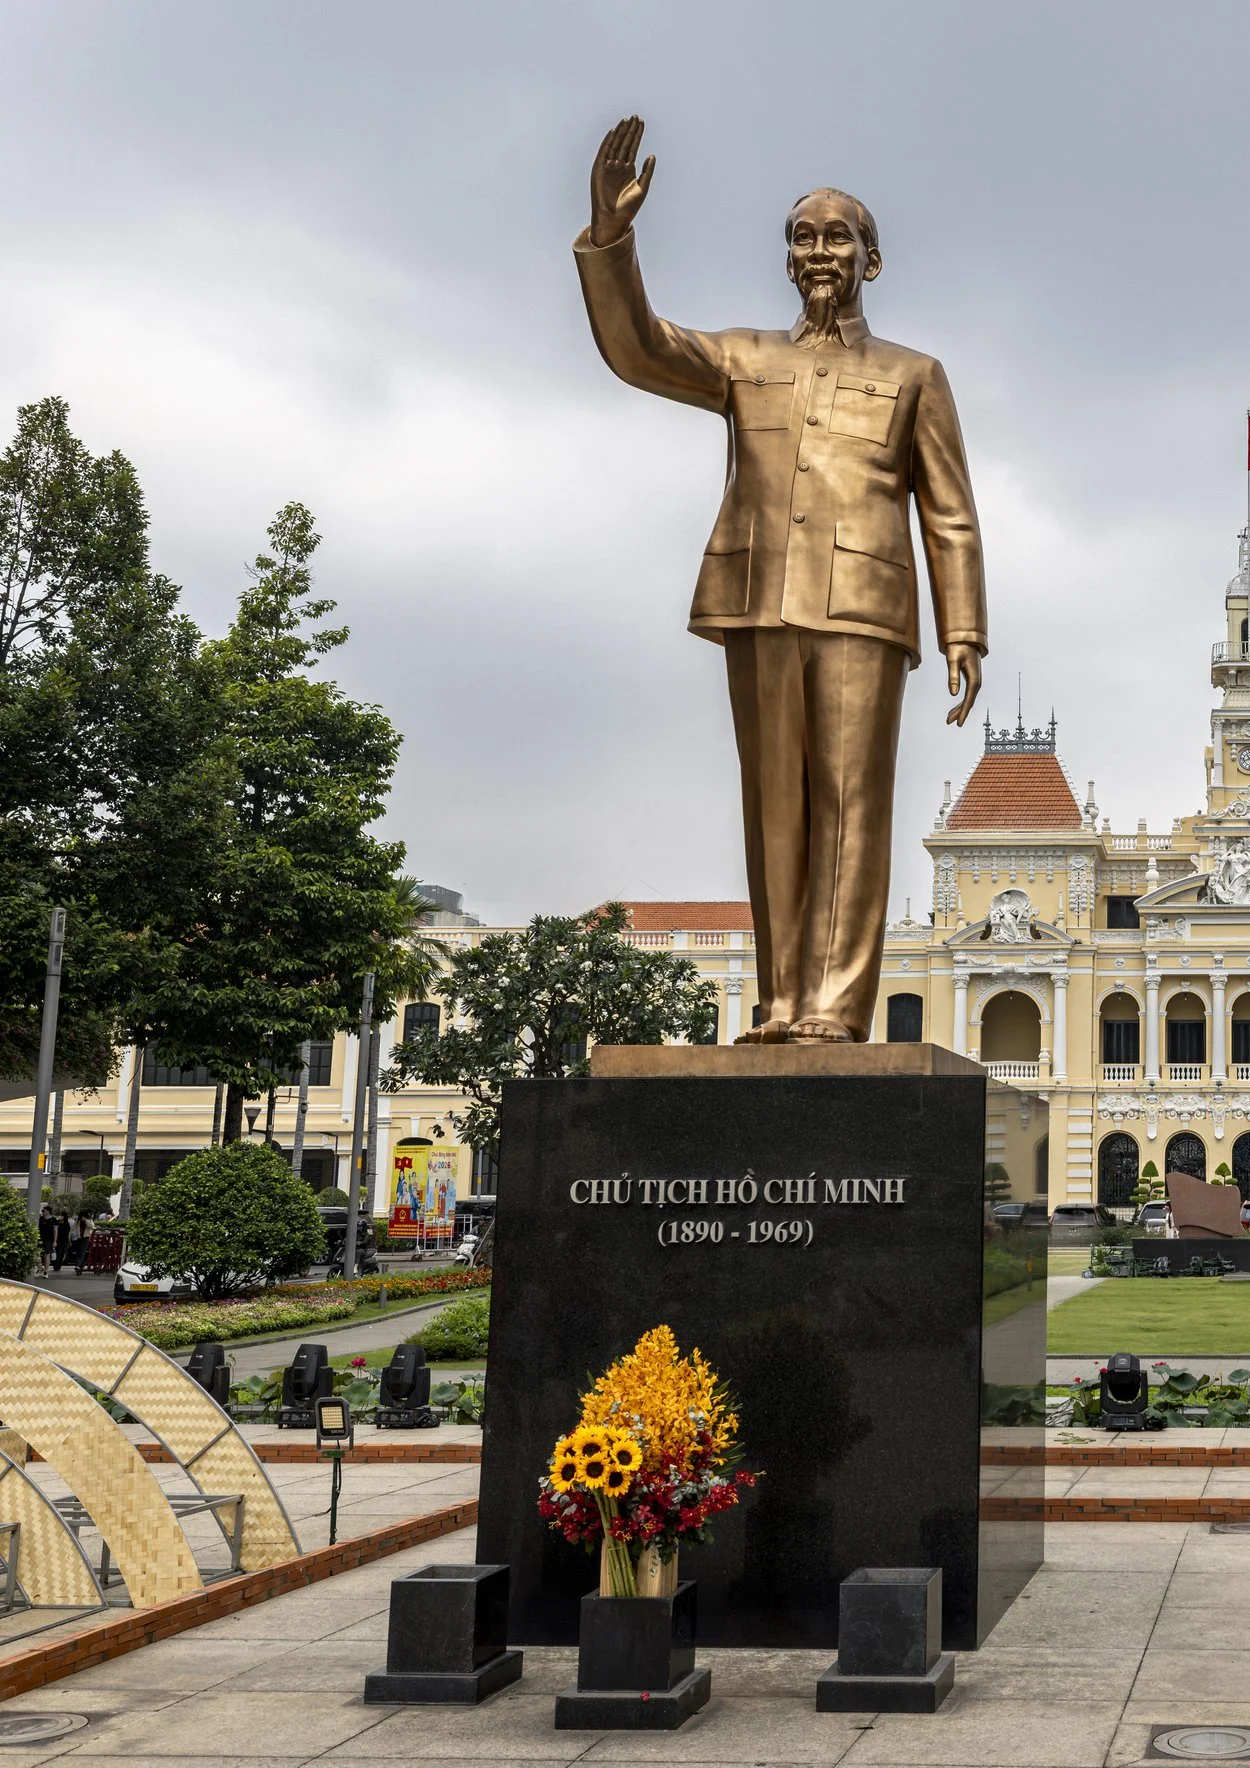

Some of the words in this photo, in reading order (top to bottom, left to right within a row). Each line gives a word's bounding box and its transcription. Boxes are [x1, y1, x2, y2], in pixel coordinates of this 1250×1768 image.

[569, 1172, 633, 1204] CHỦ
[638, 1179, 709, 1208] TỊCH
[715, 1168, 758, 1204] HỒ
[763, 1171, 817, 1204] CHÍ
[823, 1178, 906, 1204] MINH
[657, 1220, 724, 1247] (1890
[747, 1219, 814, 1247] 1969)
